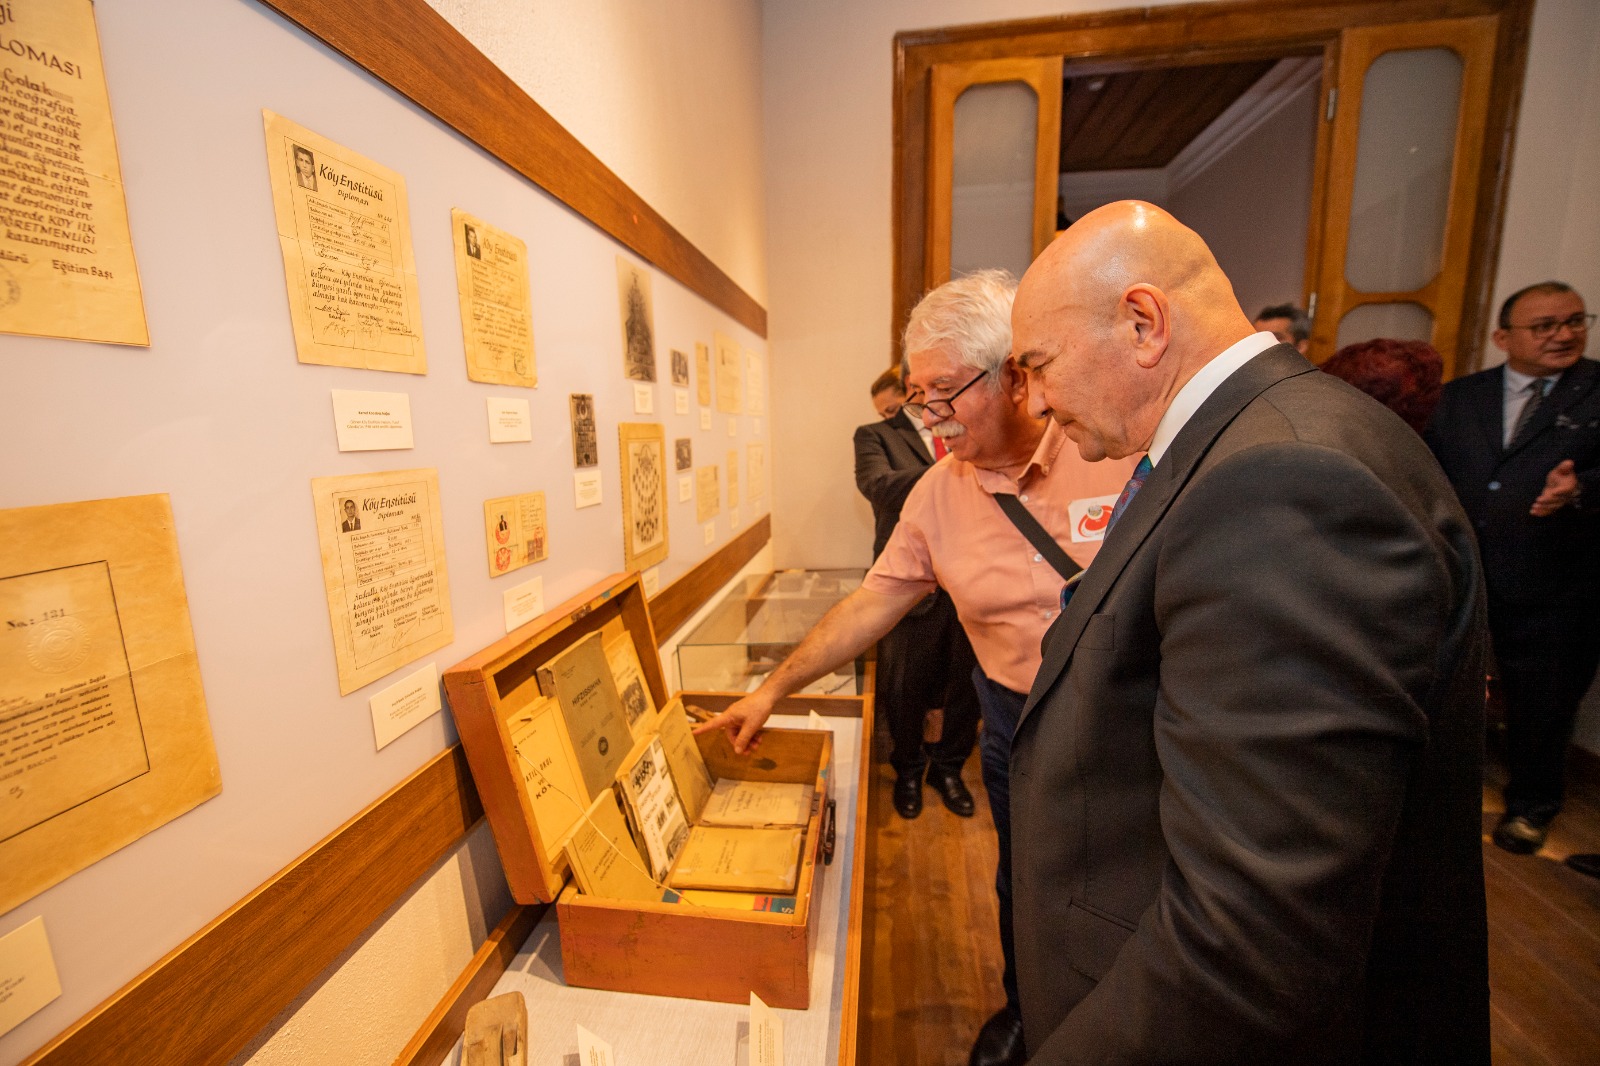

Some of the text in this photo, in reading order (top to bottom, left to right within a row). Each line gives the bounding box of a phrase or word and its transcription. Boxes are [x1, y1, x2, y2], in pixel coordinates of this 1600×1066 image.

[319, 163, 383, 201] Köy Enstitüsü
[362, 492, 417, 514] Köy Enstitüsü
